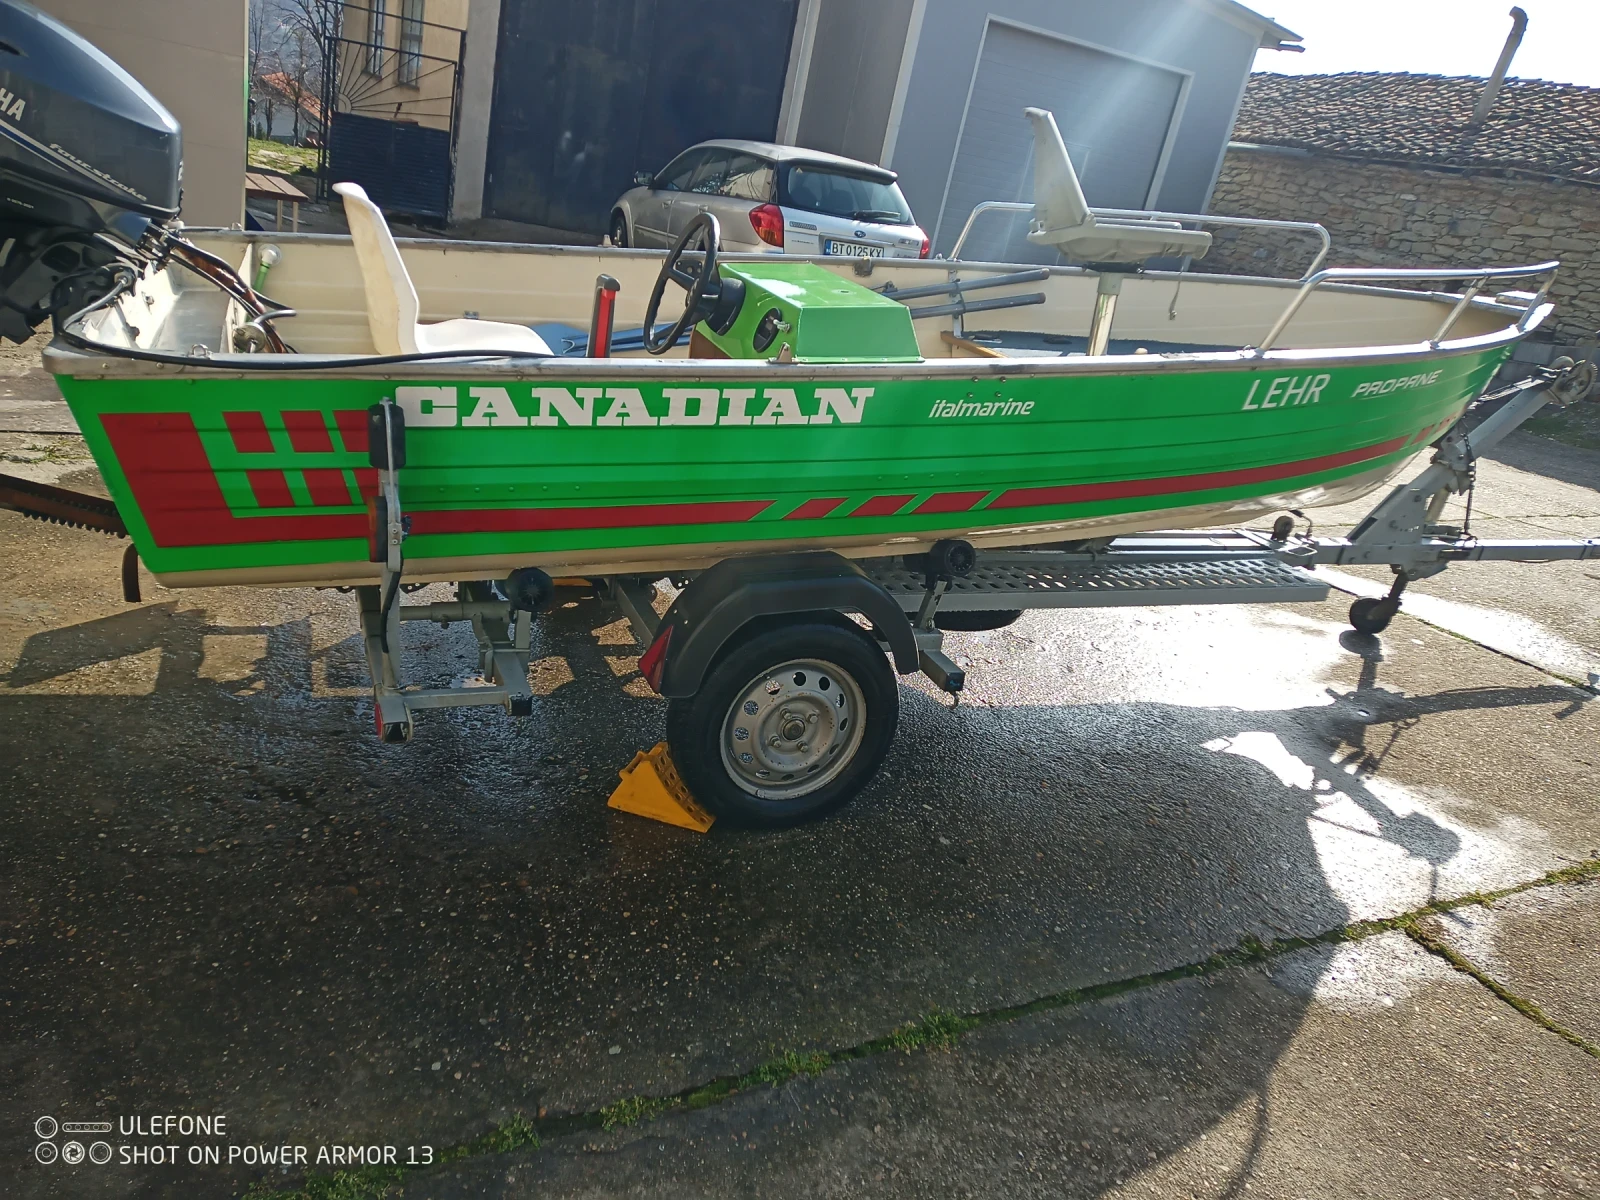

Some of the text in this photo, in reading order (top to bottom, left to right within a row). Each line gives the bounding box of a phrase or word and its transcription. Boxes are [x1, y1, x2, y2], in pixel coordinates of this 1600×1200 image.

[832, 243, 845, 255] BT
[846, 244, 869, 257] 0125
[869, 247, 882, 257] KX
[1241, 369, 1443, 411] LEHR PROPANE
[395, 386, 875, 427] CANADIAN
[928, 398, 1035, 418] italmarine
